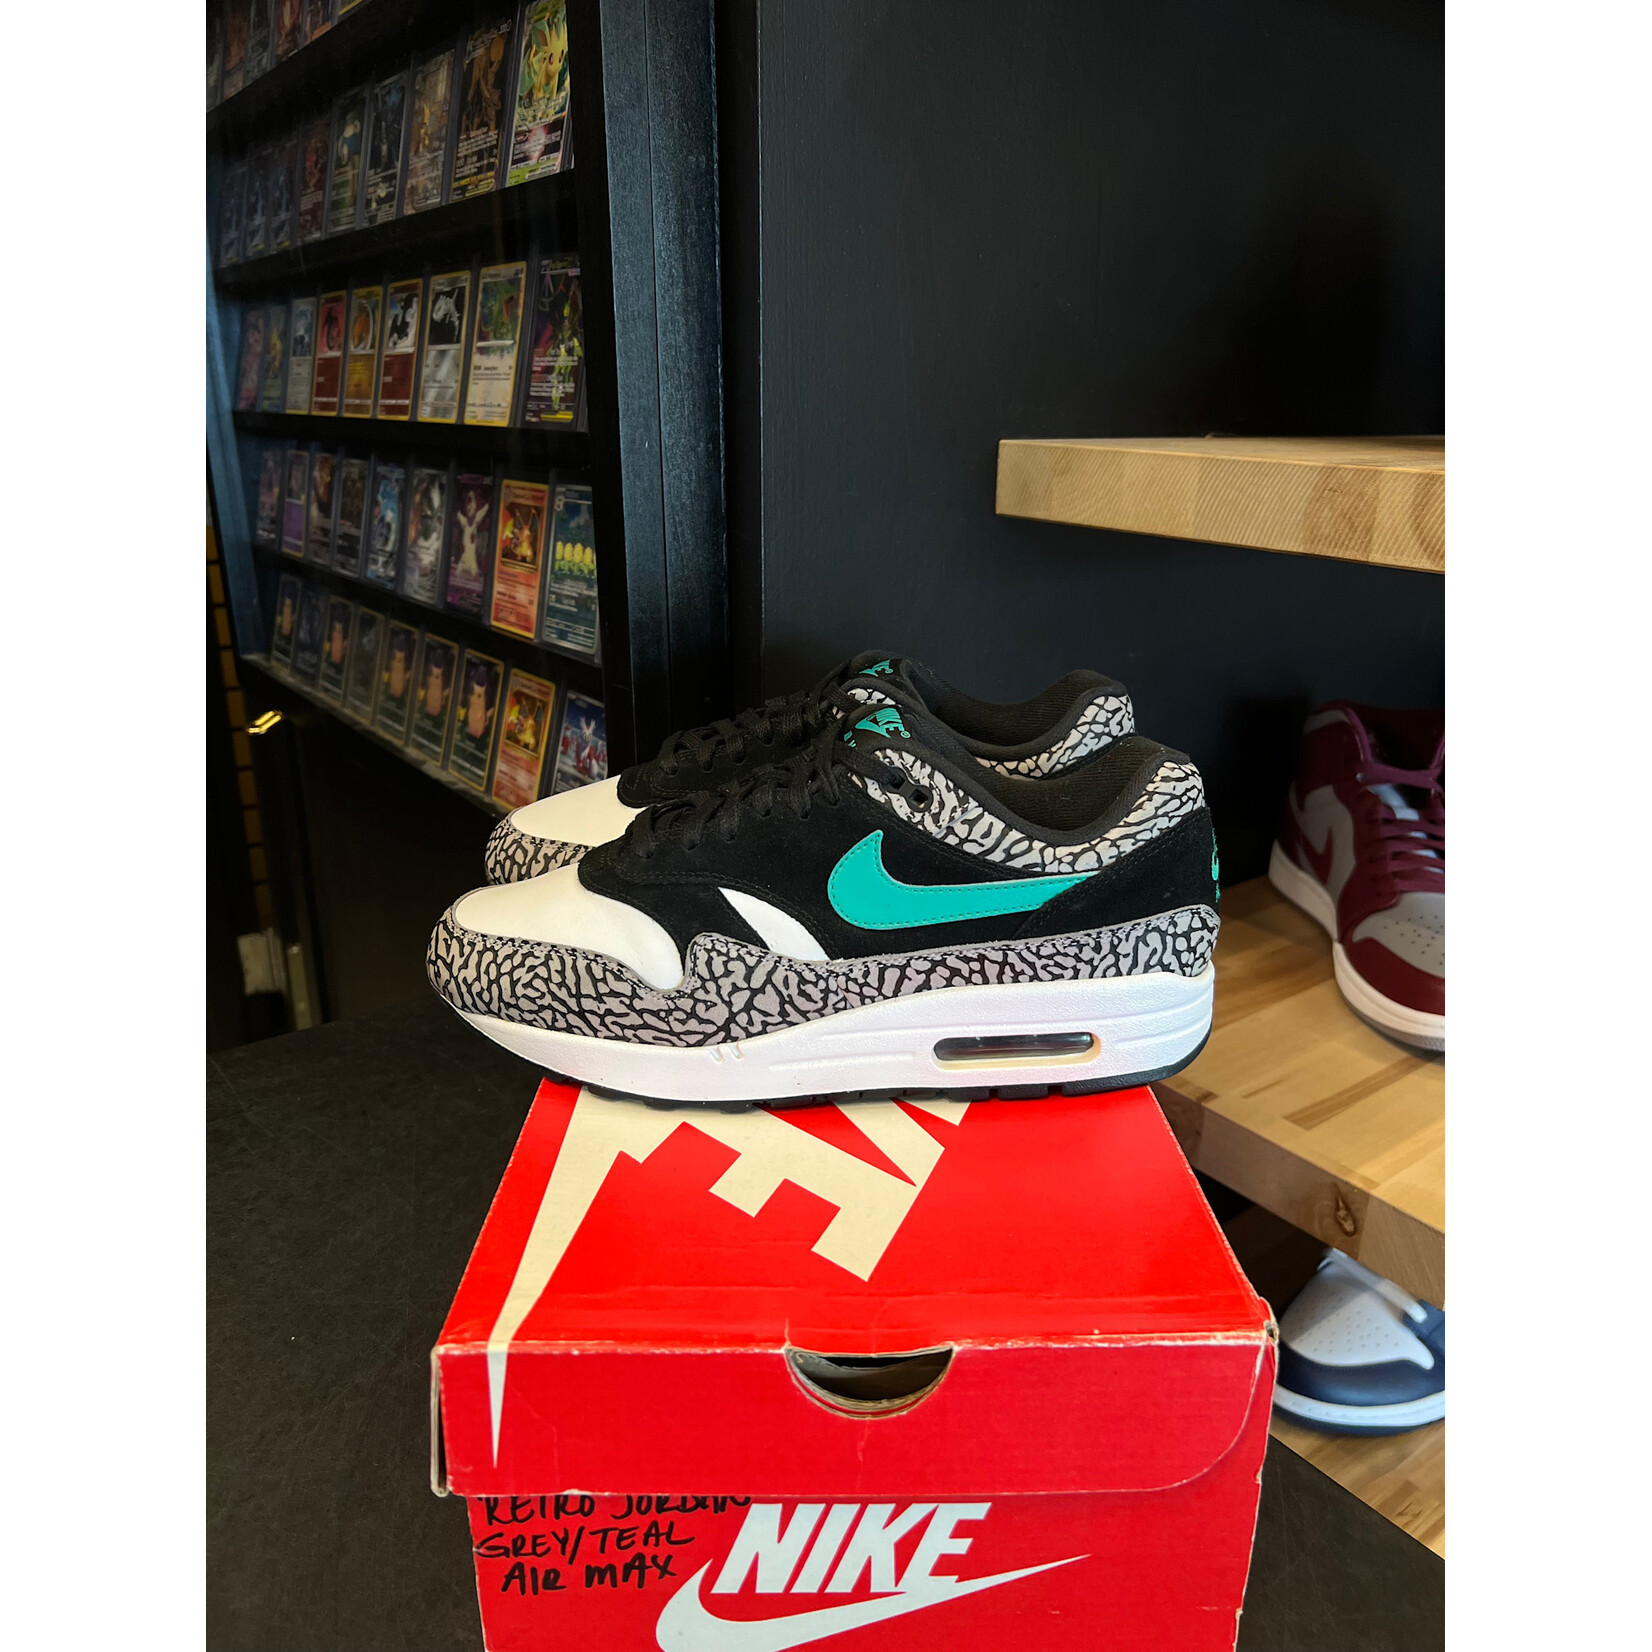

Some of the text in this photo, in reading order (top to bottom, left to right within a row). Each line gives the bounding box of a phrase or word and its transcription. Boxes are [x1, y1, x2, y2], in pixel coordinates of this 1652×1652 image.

[474, 1520, 696, 1566] GREY/TEAL
[709, 1502, 993, 1594] NIKE
[500, 1561, 567, 1597] AIR
